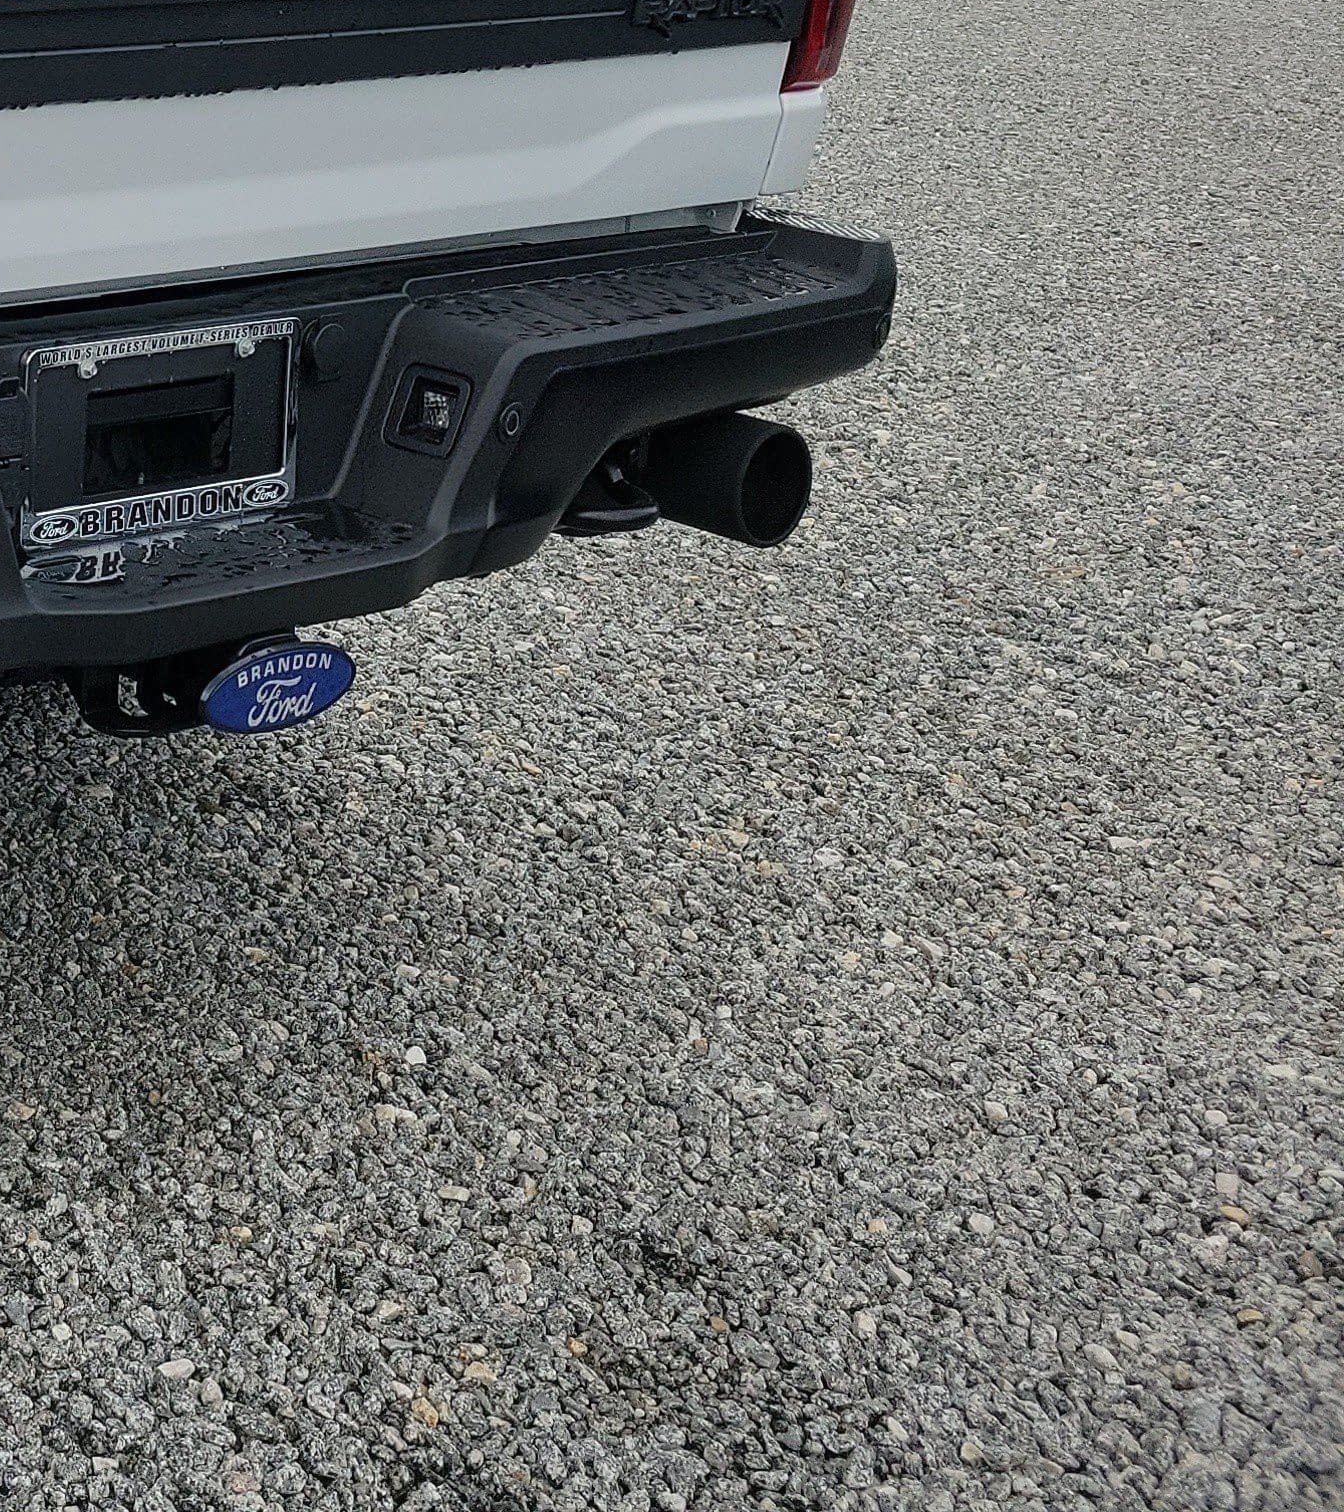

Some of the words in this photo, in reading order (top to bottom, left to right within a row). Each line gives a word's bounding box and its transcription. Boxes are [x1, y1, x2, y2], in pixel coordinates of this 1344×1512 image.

[40, 348, 92, 366] WORLD'S
[96, 340, 147, 357] LARGEST
[151, 334, 195, 350] VOLUME
[197, 326, 248, 344] F-SERIES
[252, 321, 293, 337] DEALER
[39, 521, 69, 539] Ford
[80, 484, 243, 537] BRANDON
[252, 486, 279, 502] Ford
[237, 653, 332, 689] BRANDON
[247, 675, 318, 727] Ford
